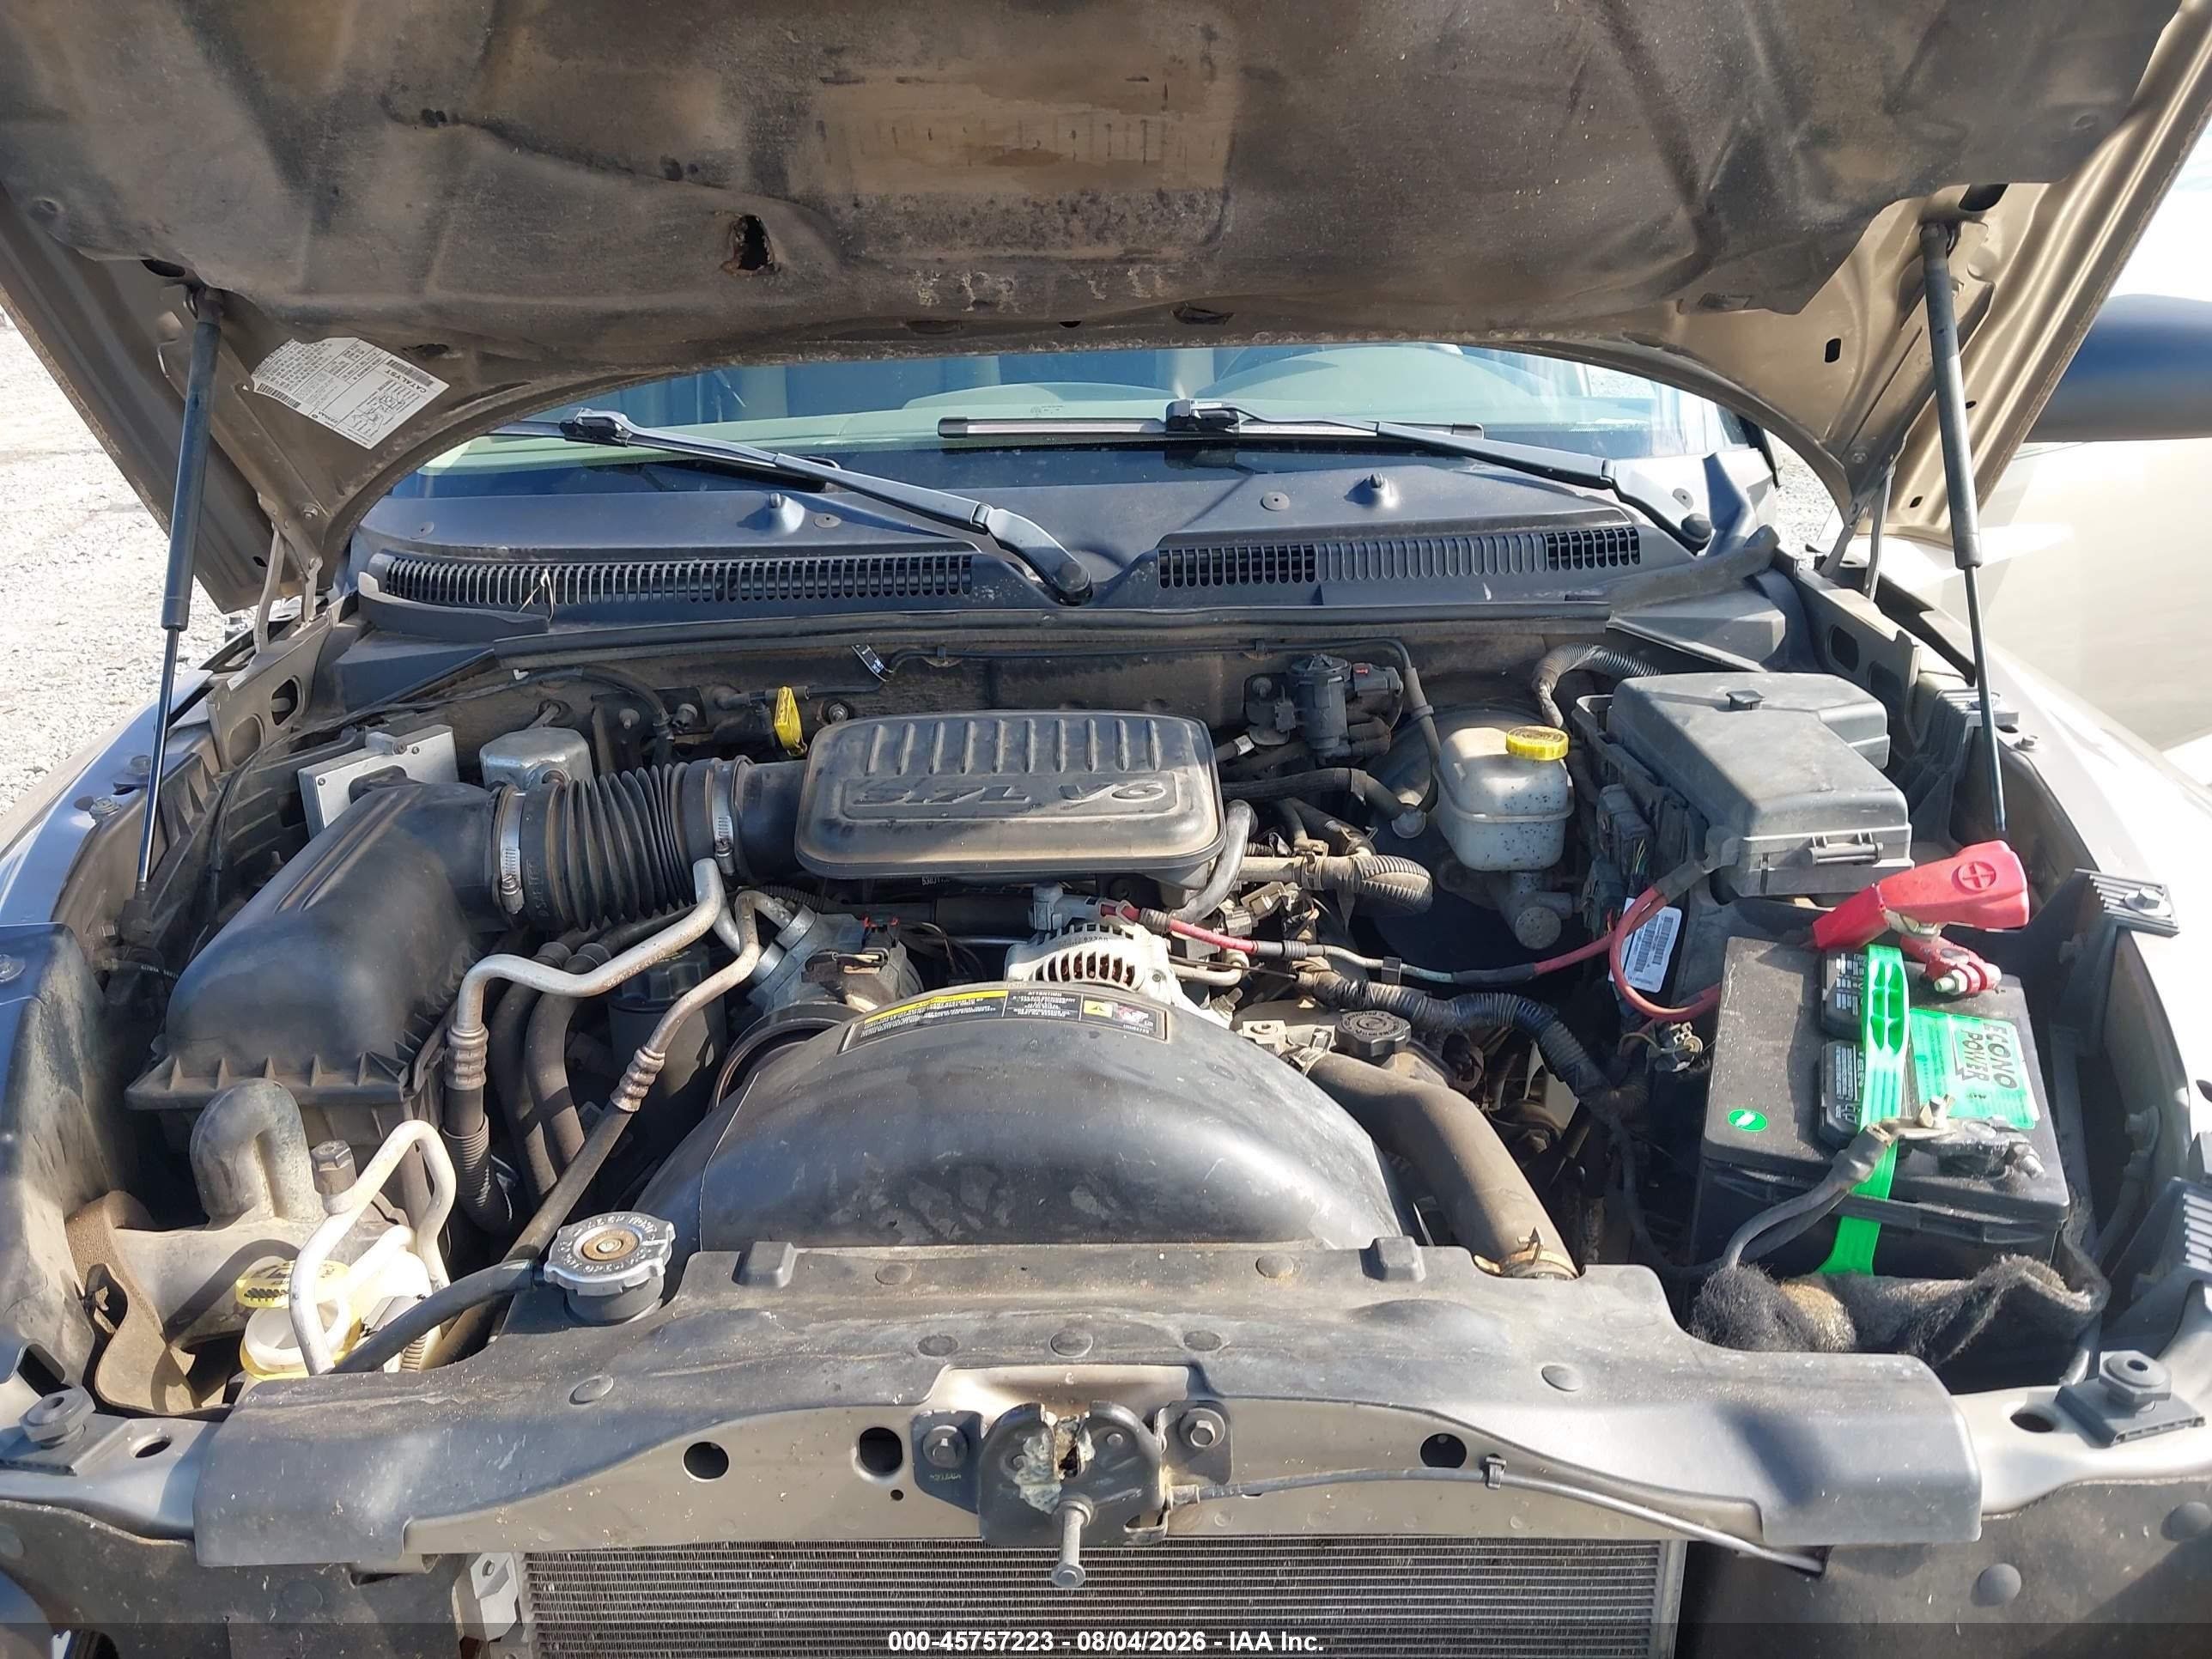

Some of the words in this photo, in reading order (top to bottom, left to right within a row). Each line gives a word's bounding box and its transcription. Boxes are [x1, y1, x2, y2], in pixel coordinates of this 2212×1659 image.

[386, 369, 428, 393] CATALYST
[1058, 782, 1168, 804] V6
[1960, 1030, 1990, 1082] POWER
[1983, 1023, 2018, 1090] ECONO
